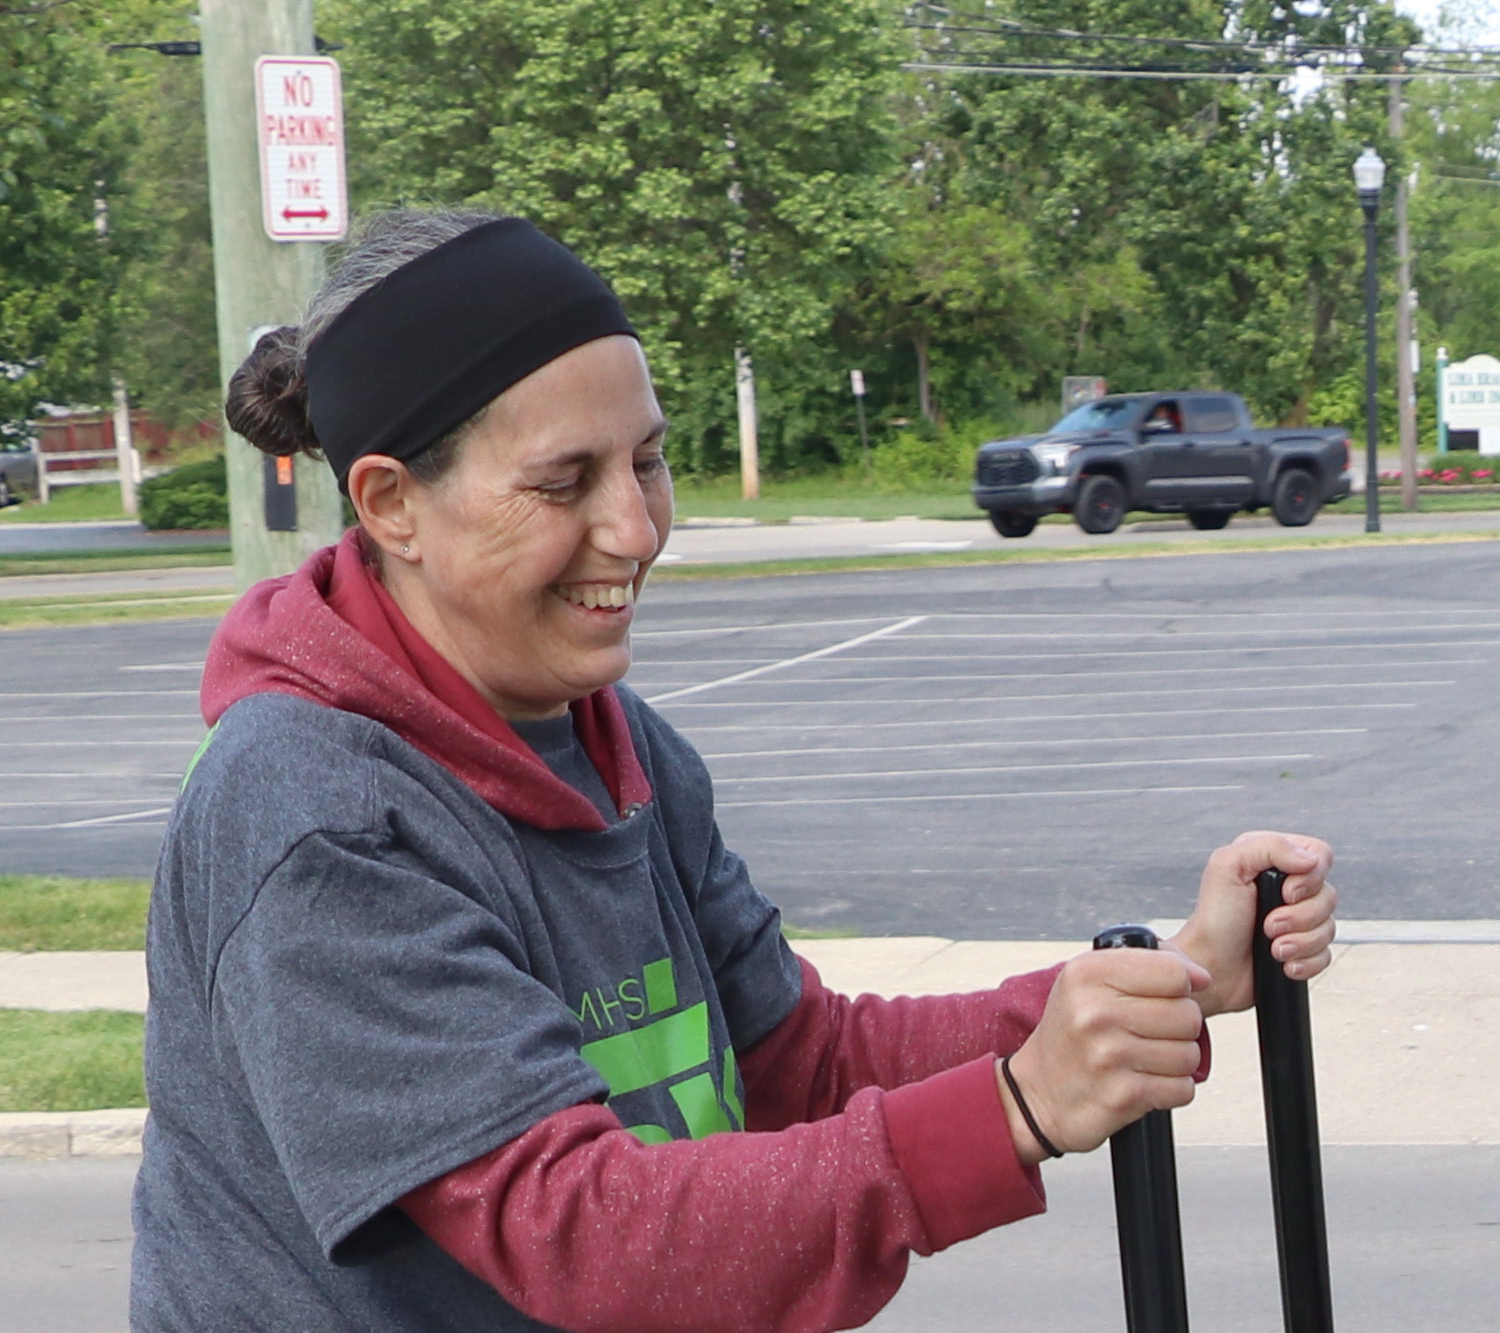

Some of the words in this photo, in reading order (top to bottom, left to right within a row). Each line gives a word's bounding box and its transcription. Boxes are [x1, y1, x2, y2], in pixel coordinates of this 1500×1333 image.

[283, 75, 313, 107] NO
[266, 114, 336, 147] PARKING
[288, 152, 318, 172] ANY
[286, 178, 322, 199] TIME
